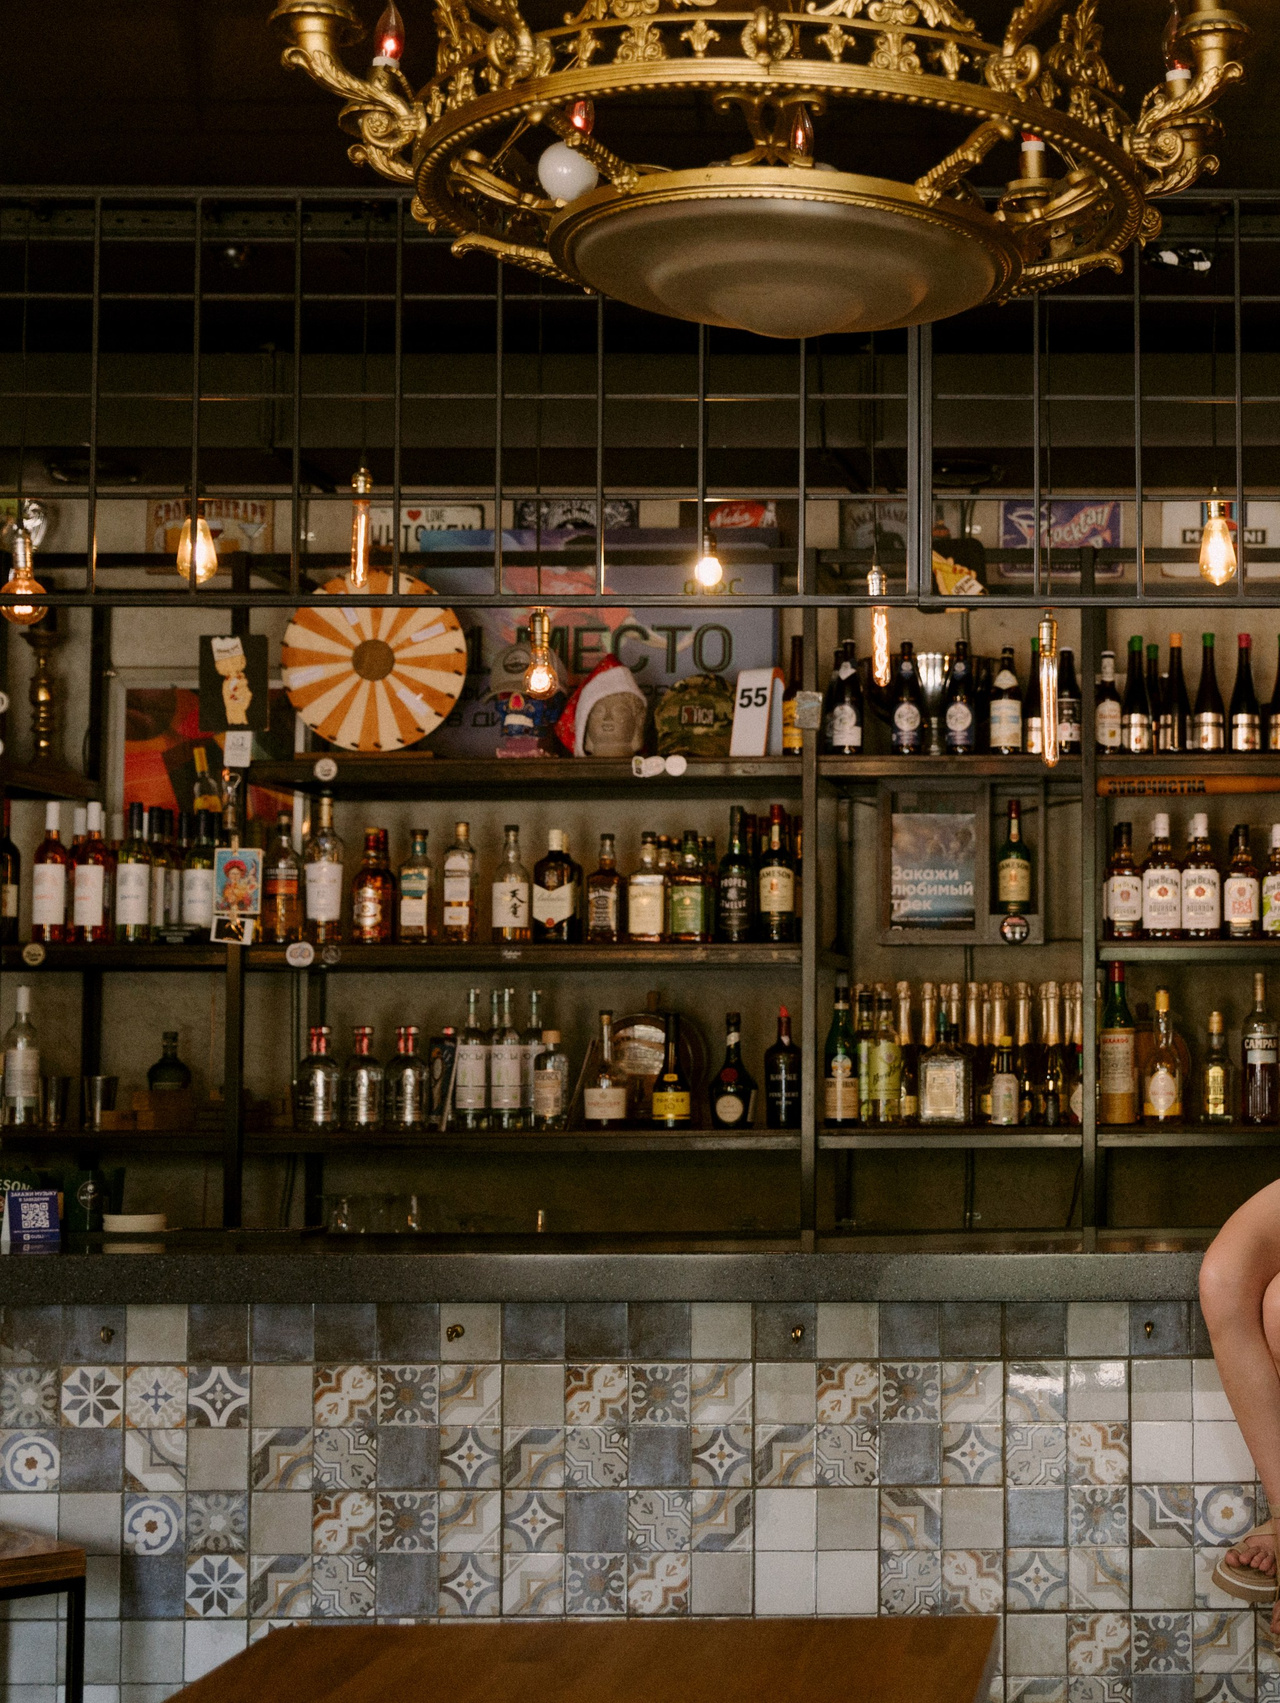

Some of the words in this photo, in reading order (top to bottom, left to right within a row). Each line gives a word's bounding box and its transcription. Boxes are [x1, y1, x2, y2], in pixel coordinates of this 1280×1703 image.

[516, 623, 733, 674] МЕСТО
[738, 688, 768, 709] 55
[1107, 779, 1207, 795] ЗУБОЧИСТКА
[892, 865, 960, 881] Закажи
[891, 881, 974, 896] любимый
[891, 899, 932, 914] трек
